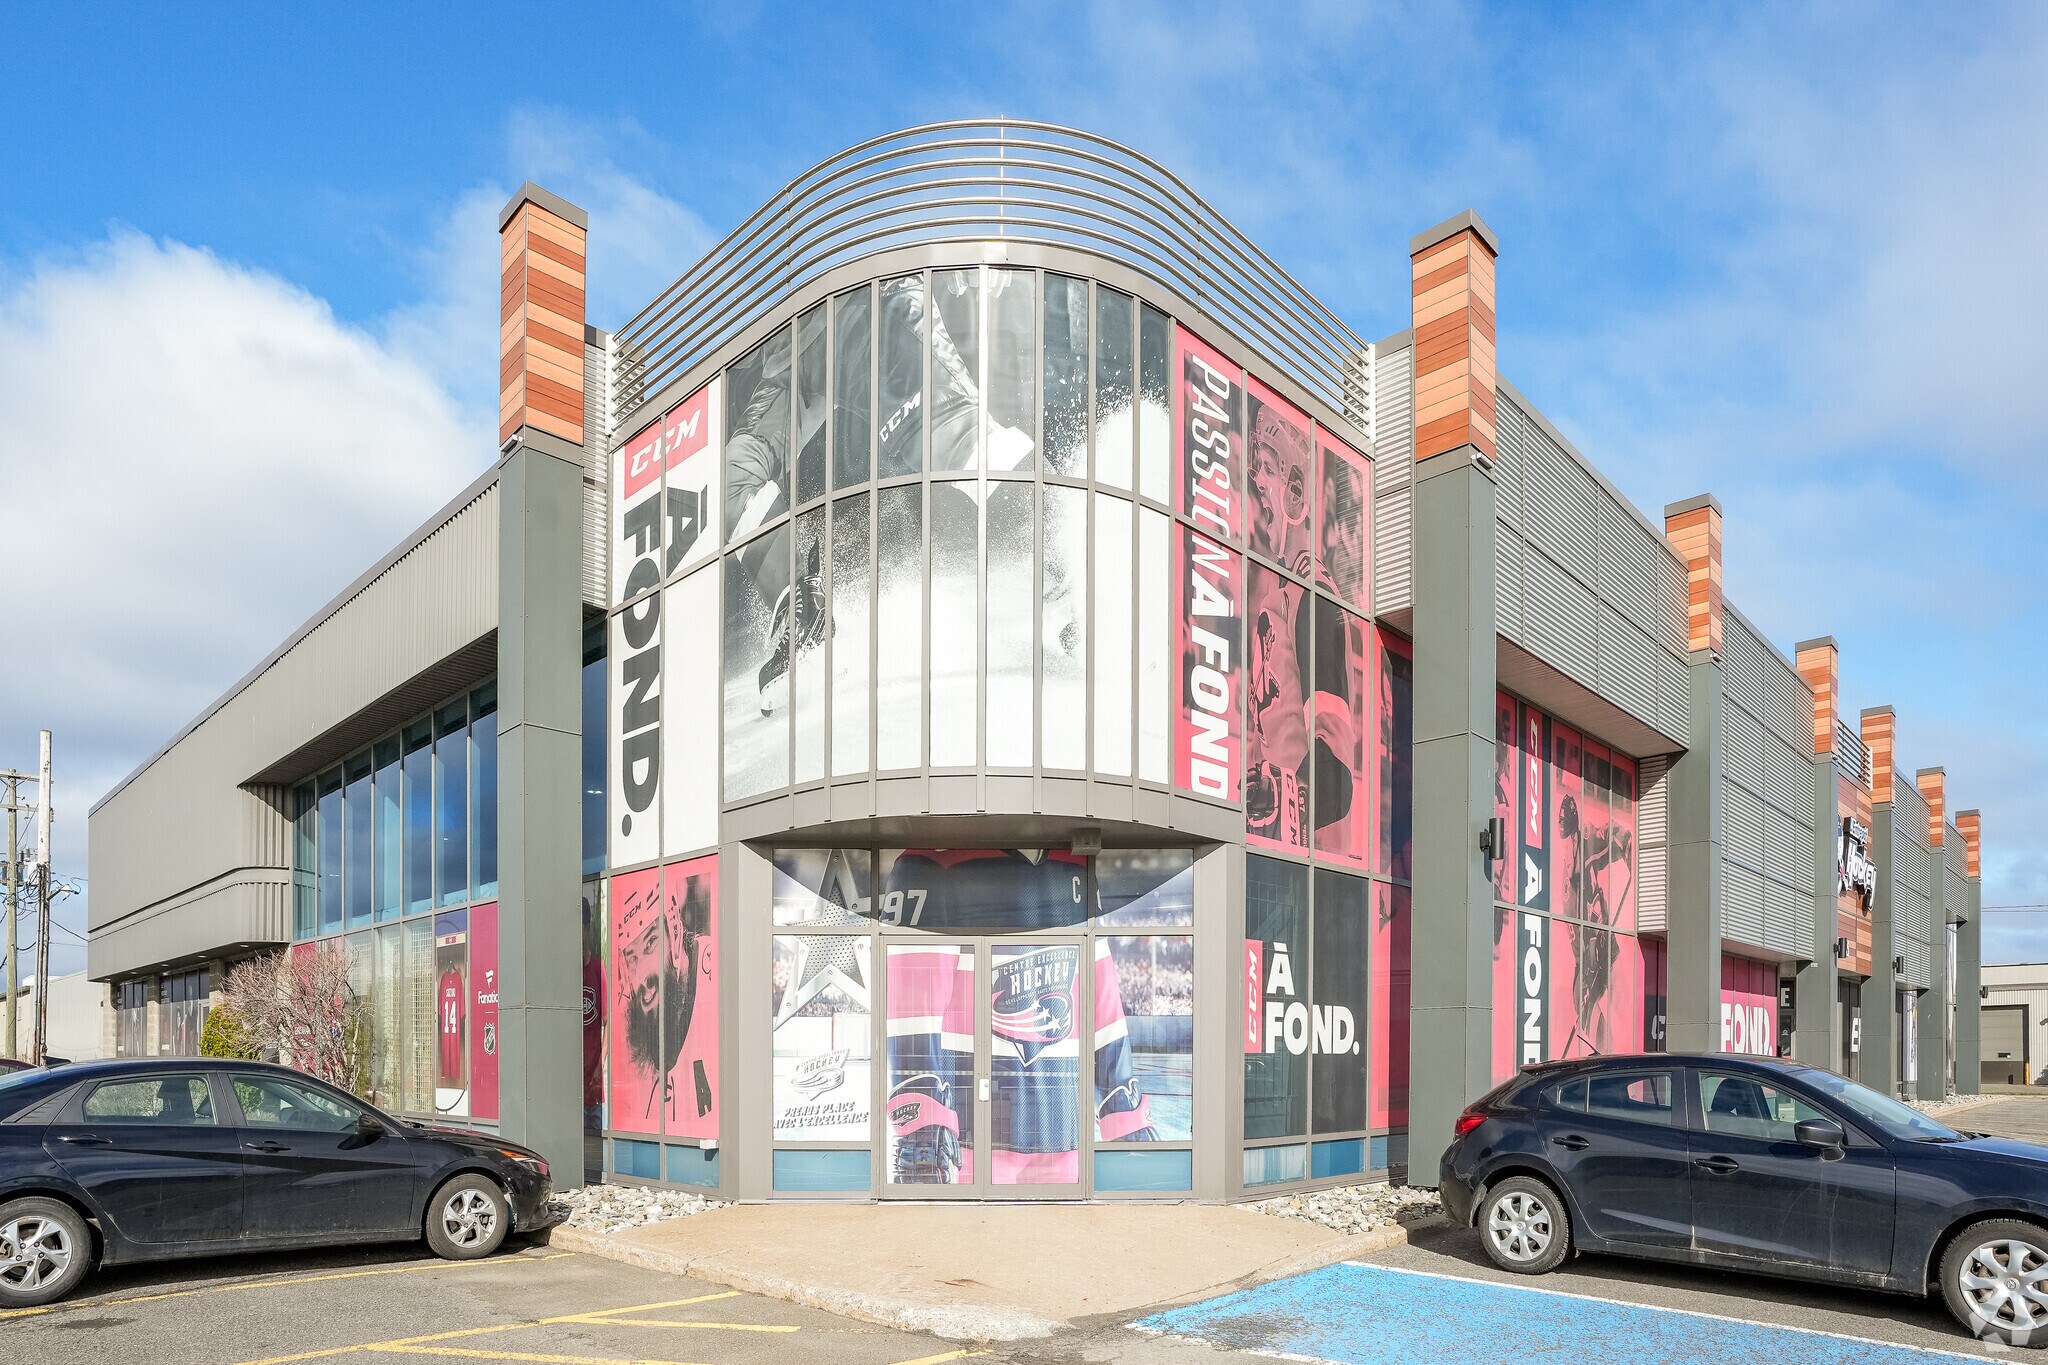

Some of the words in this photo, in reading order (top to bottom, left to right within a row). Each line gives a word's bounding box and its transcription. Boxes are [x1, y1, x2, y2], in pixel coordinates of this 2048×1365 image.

[630, 408, 702, 478] CCM
[879, 391, 921, 443] CCM
[1191, 568, 1235, 618] À
[622, 490, 661, 838] FOND.
[1190, 624, 1230, 801] FOND
[1286, 773, 1298, 846] CCM
[1072, 875, 1082, 904] C
[1524, 852, 1543, 905] À
[623, 902, 642, 924] CCM
[880, 889, 928, 926] 97
[1003, 957, 1034, 975] CENTRE
[1010, 961, 1070, 995] HOCKEY
[1266, 942, 1295, 996] À
[444, 1000, 457, 1034] 14
[1249, 948, 1258, 1044] CCM
[1265, 1001, 1360, 1056] FOND.
[803, 1055, 841, 1074] HOCKEY
